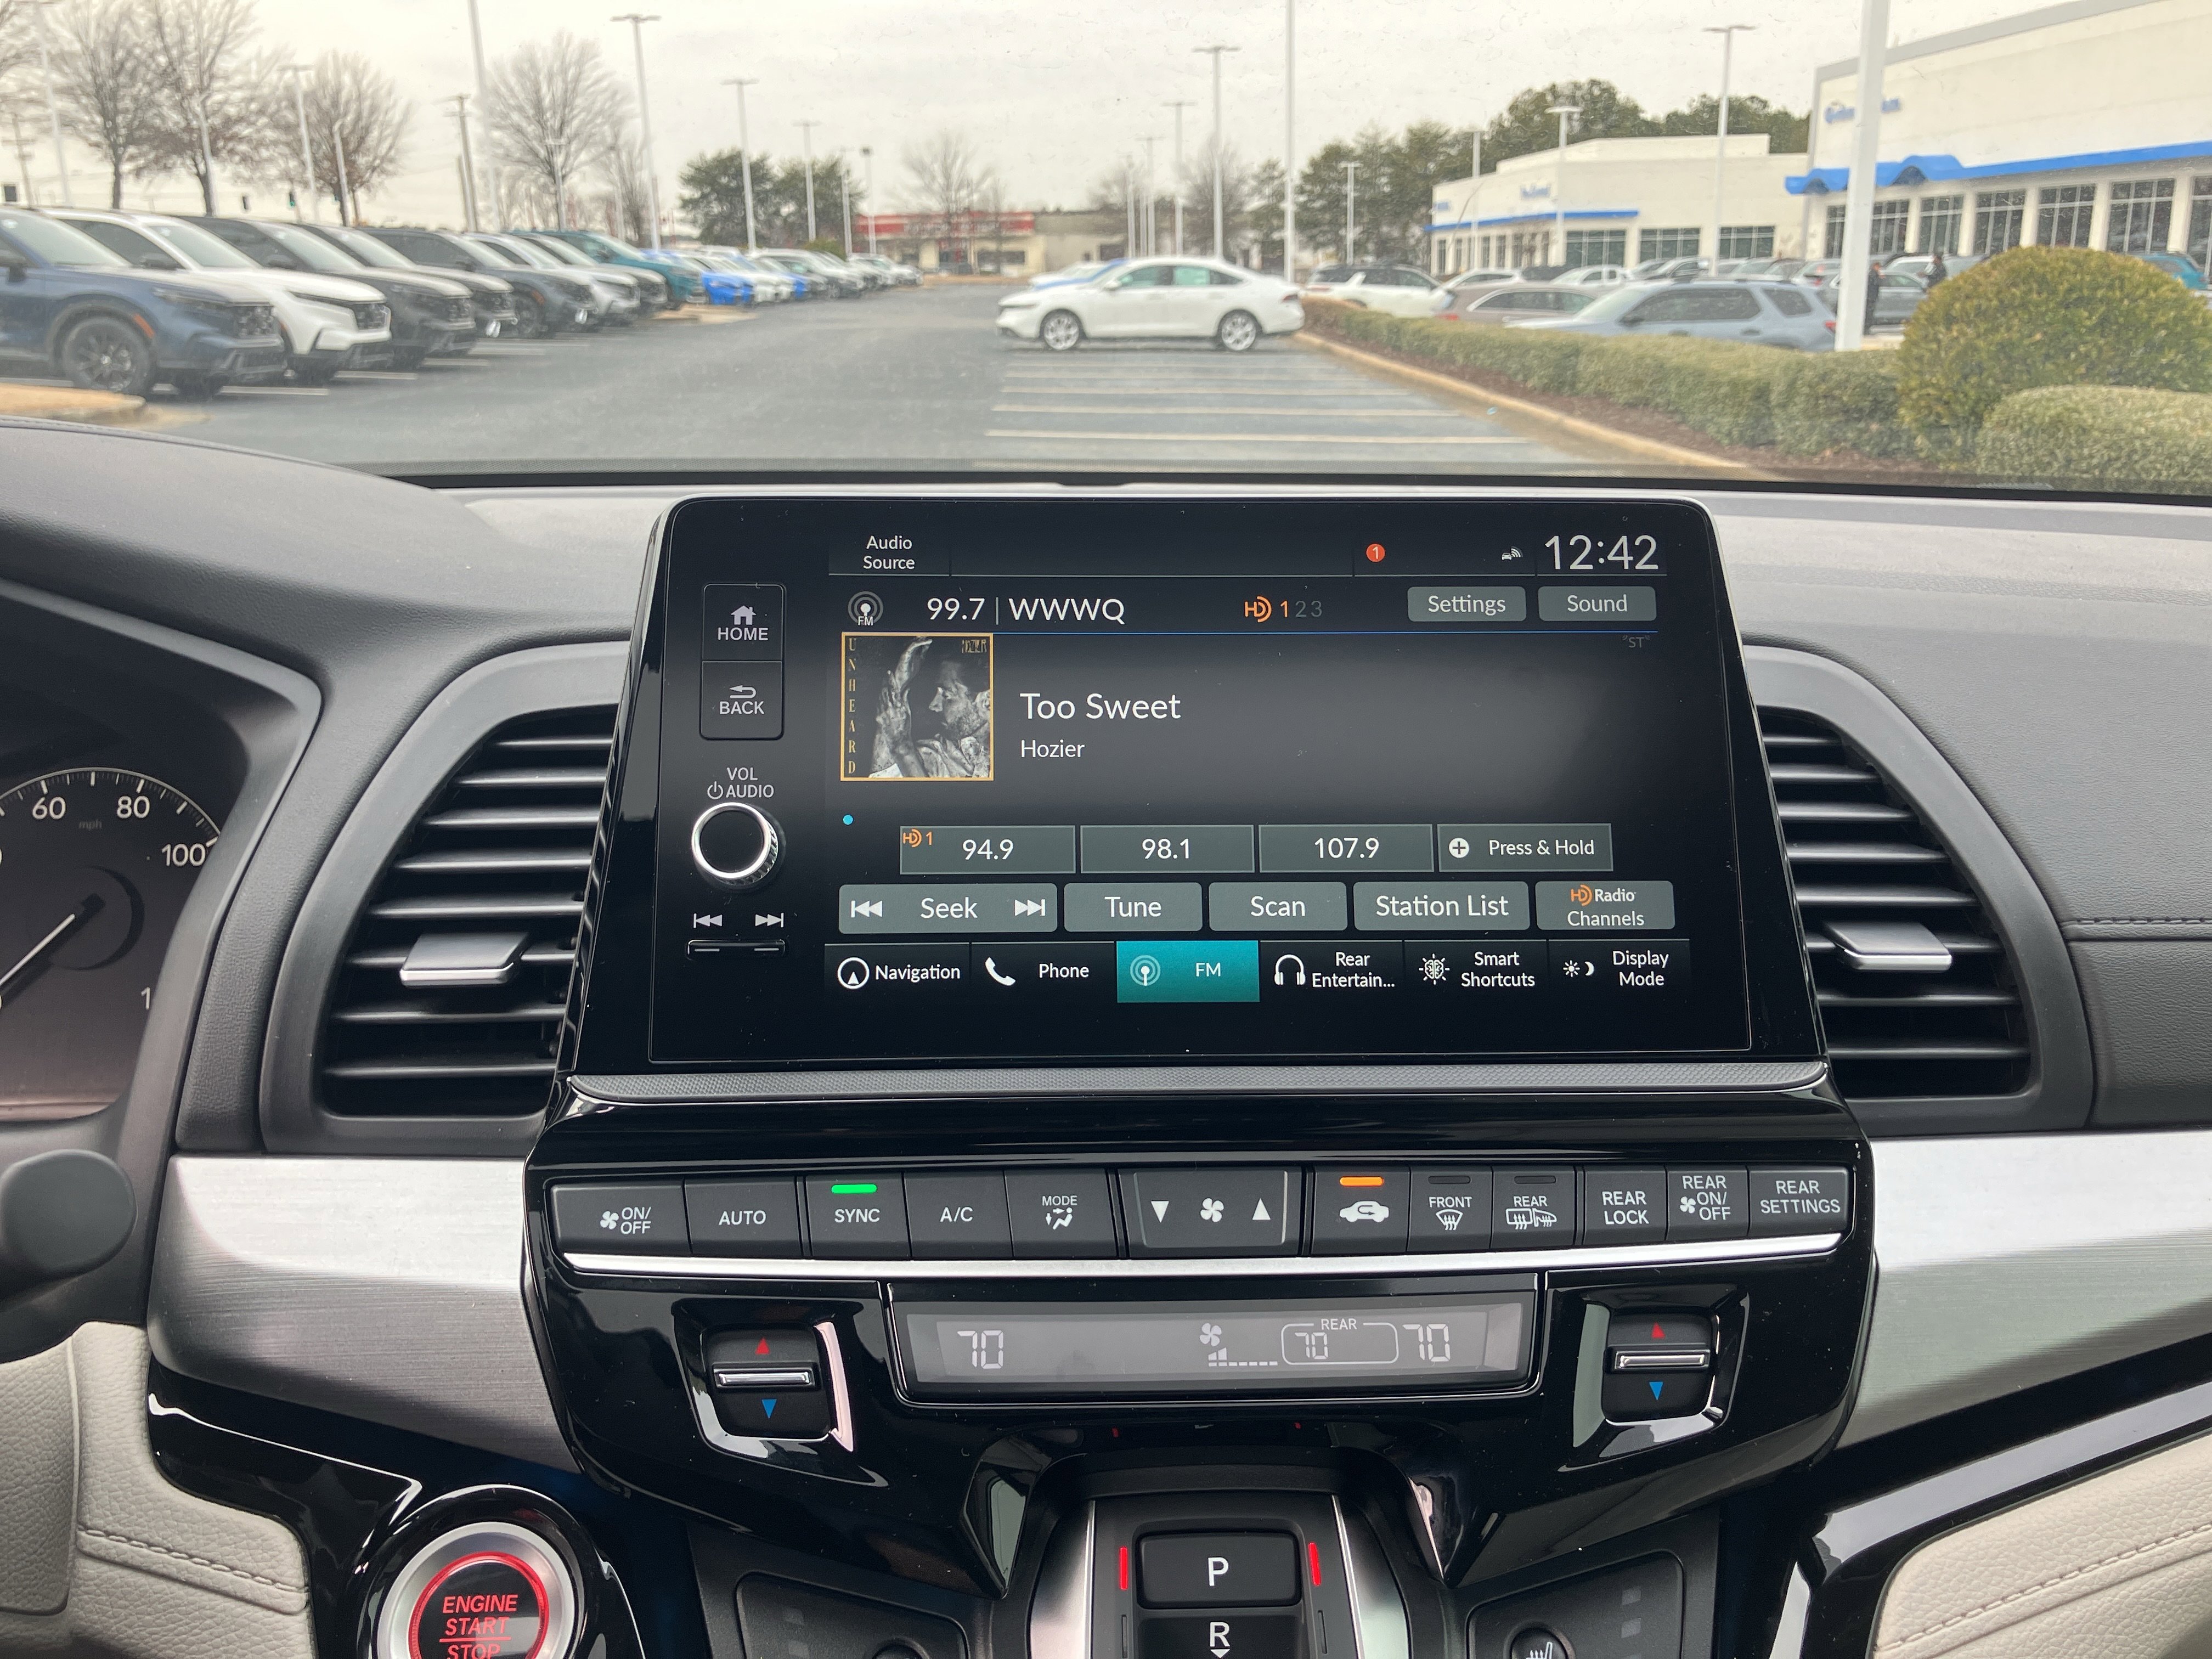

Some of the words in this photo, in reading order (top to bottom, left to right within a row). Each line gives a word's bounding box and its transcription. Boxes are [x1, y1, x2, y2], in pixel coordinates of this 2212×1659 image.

[867, 535, 912, 549] Audio
[1545, 535, 1658, 569] 12:42
[864, 556, 915, 569] Source
[928, 598, 985, 620] 99.7
[1009, 599, 1125, 624] WWWQ
[1429, 595, 1505, 616] Settings
[1567, 595, 1627, 612] Sound
[858, 616, 873, 625] FM
[718, 628, 768, 640] HOME
[720, 702, 764, 714] BACK
[1020, 693, 1075, 719] Too
[1086, 693, 1181, 719] Sweet
[1022, 740, 1085, 757] Hozier
[727, 768, 758, 780] VOL
[726, 785, 774, 798] AUDIO
[32, 797, 65, 819] 60
[117, 796, 150, 818] 80
[963, 839, 1013, 860] 94.9
[1142, 839, 1189, 859] 98.1
[1314, 838, 1379, 858] 107.9
[1489, 840, 1532, 855] Press
[1537, 840, 1550, 855] &
[1556, 840, 1594, 854] Hold
[162, 844, 206, 867] 100
[1595, 889, 1634, 901] Radio
[921, 897, 978, 918] Seek
[1105, 897, 1161, 917] Tune
[1251, 896, 1305, 916] Scan
[1376, 895, 1459, 916] Station
[1468, 895, 1509, 916] List
[1568, 911, 1644, 926] Channels
[1336, 952, 1370, 966] Rear
[1475, 952, 1519, 966] Smart
[1613, 950, 1668, 968] Display
[876, 965, 960, 983] Navigation
[1040, 963, 1089, 978] Phone
[1196, 963, 1221, 977] FM
[1312, 973, 1395, 987] Entertain...
[1462, 972, 1535, 986] Shortcuts
[1620, 971, 1664, 986] Mode
[1683, 1176, 1727, 1189] REAR
[1776, 1180, 1820, 1194] REAR
[1042, 1195, 1077, 1206] MODE
[1429, 1197, 1472, 1207] FRONT
[1514, 1196, 1547, 1207] REAR
[1602, 1191, 1646, 1205] REAR
[1697, 1192, 1726, 1205] ON/
[622, 1207, 651, 1220] ON/
[1700, 1207, 1731, 1220] OFF
[1760, 1199, 1840, 1214] SETTINGS
[719, 1210, 766, 1225] AUTO
[835, 1209, 880, 1222] SYNC
[940, 1207, 973, 1222] A/C
[1605, 1210, 1649, 1224] LOCK
[620, 1221, 651, 1234] OFF
[1321, 1318, 1357, 1330] REAR
[957, 1330, 1003, 1369] 70
[1295, 1332, 1328, 1359] 70
[1402, 1324, 1451, 1362] 70
[1208, 1558, 1228, 1586] P
[443, 1594, 518, 1613] ENGINE
[445, 1616, 509, 1636] START
[1210, 1622, 1230, 1646] R
[448, 1644, 500, 1659] STOP
